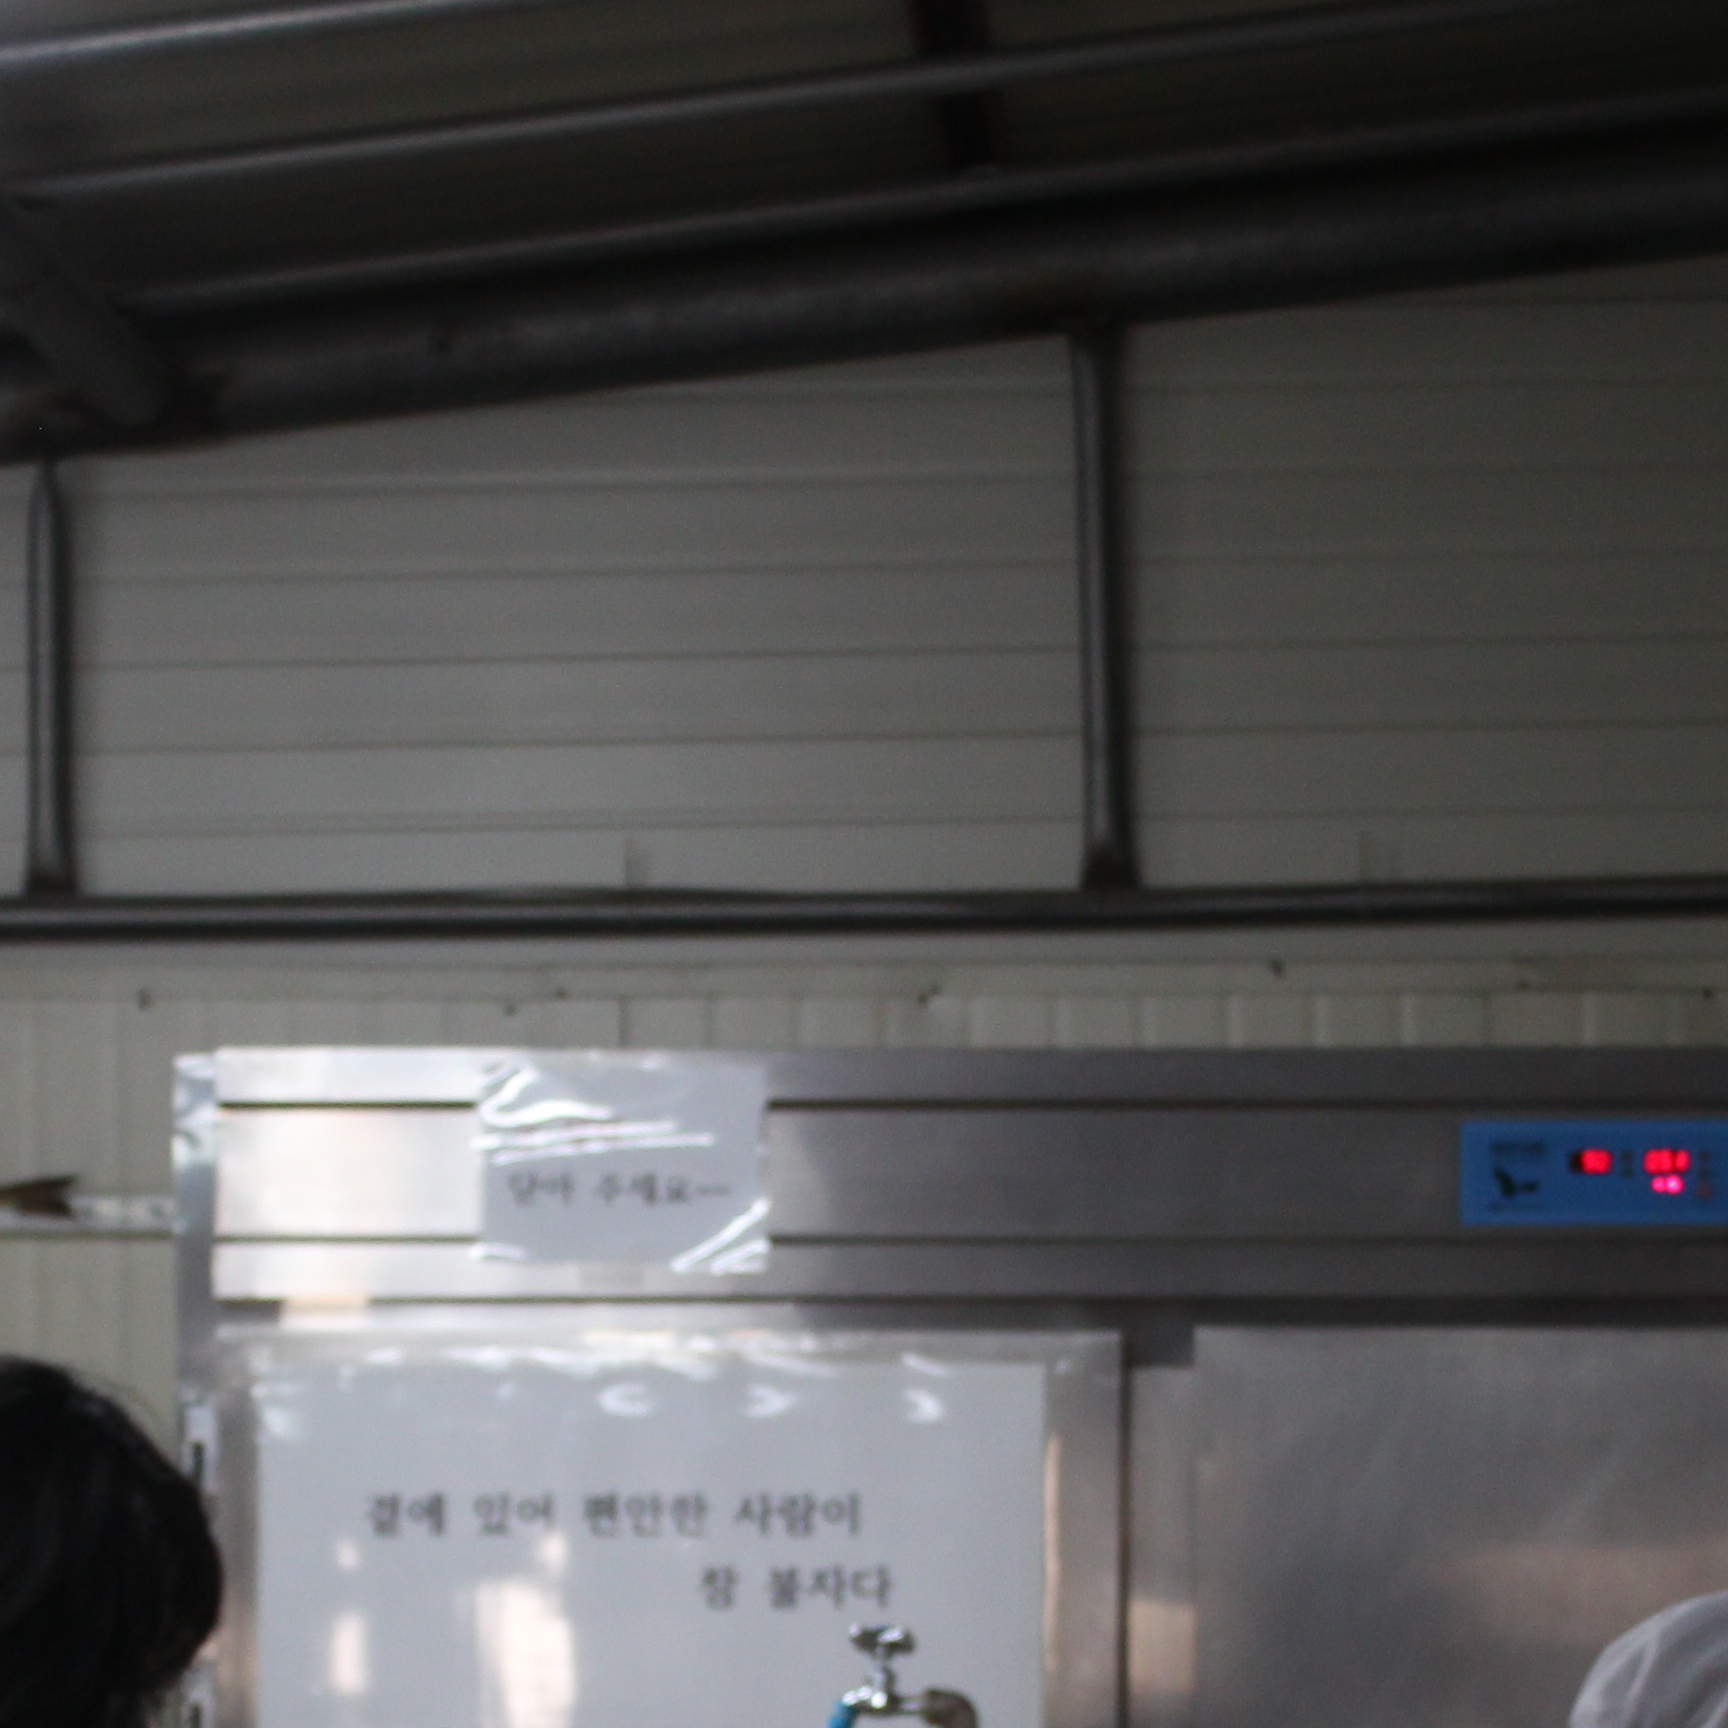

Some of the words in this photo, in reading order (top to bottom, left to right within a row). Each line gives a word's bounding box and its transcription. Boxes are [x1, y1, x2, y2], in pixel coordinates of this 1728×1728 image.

[474, 1492, 556, 1536] 있어
[584, 1492, 707, 1538] 편안한
[736, 1491, 862, 1537] 사람이
[768, 1566, 893, 1610] 불자다
